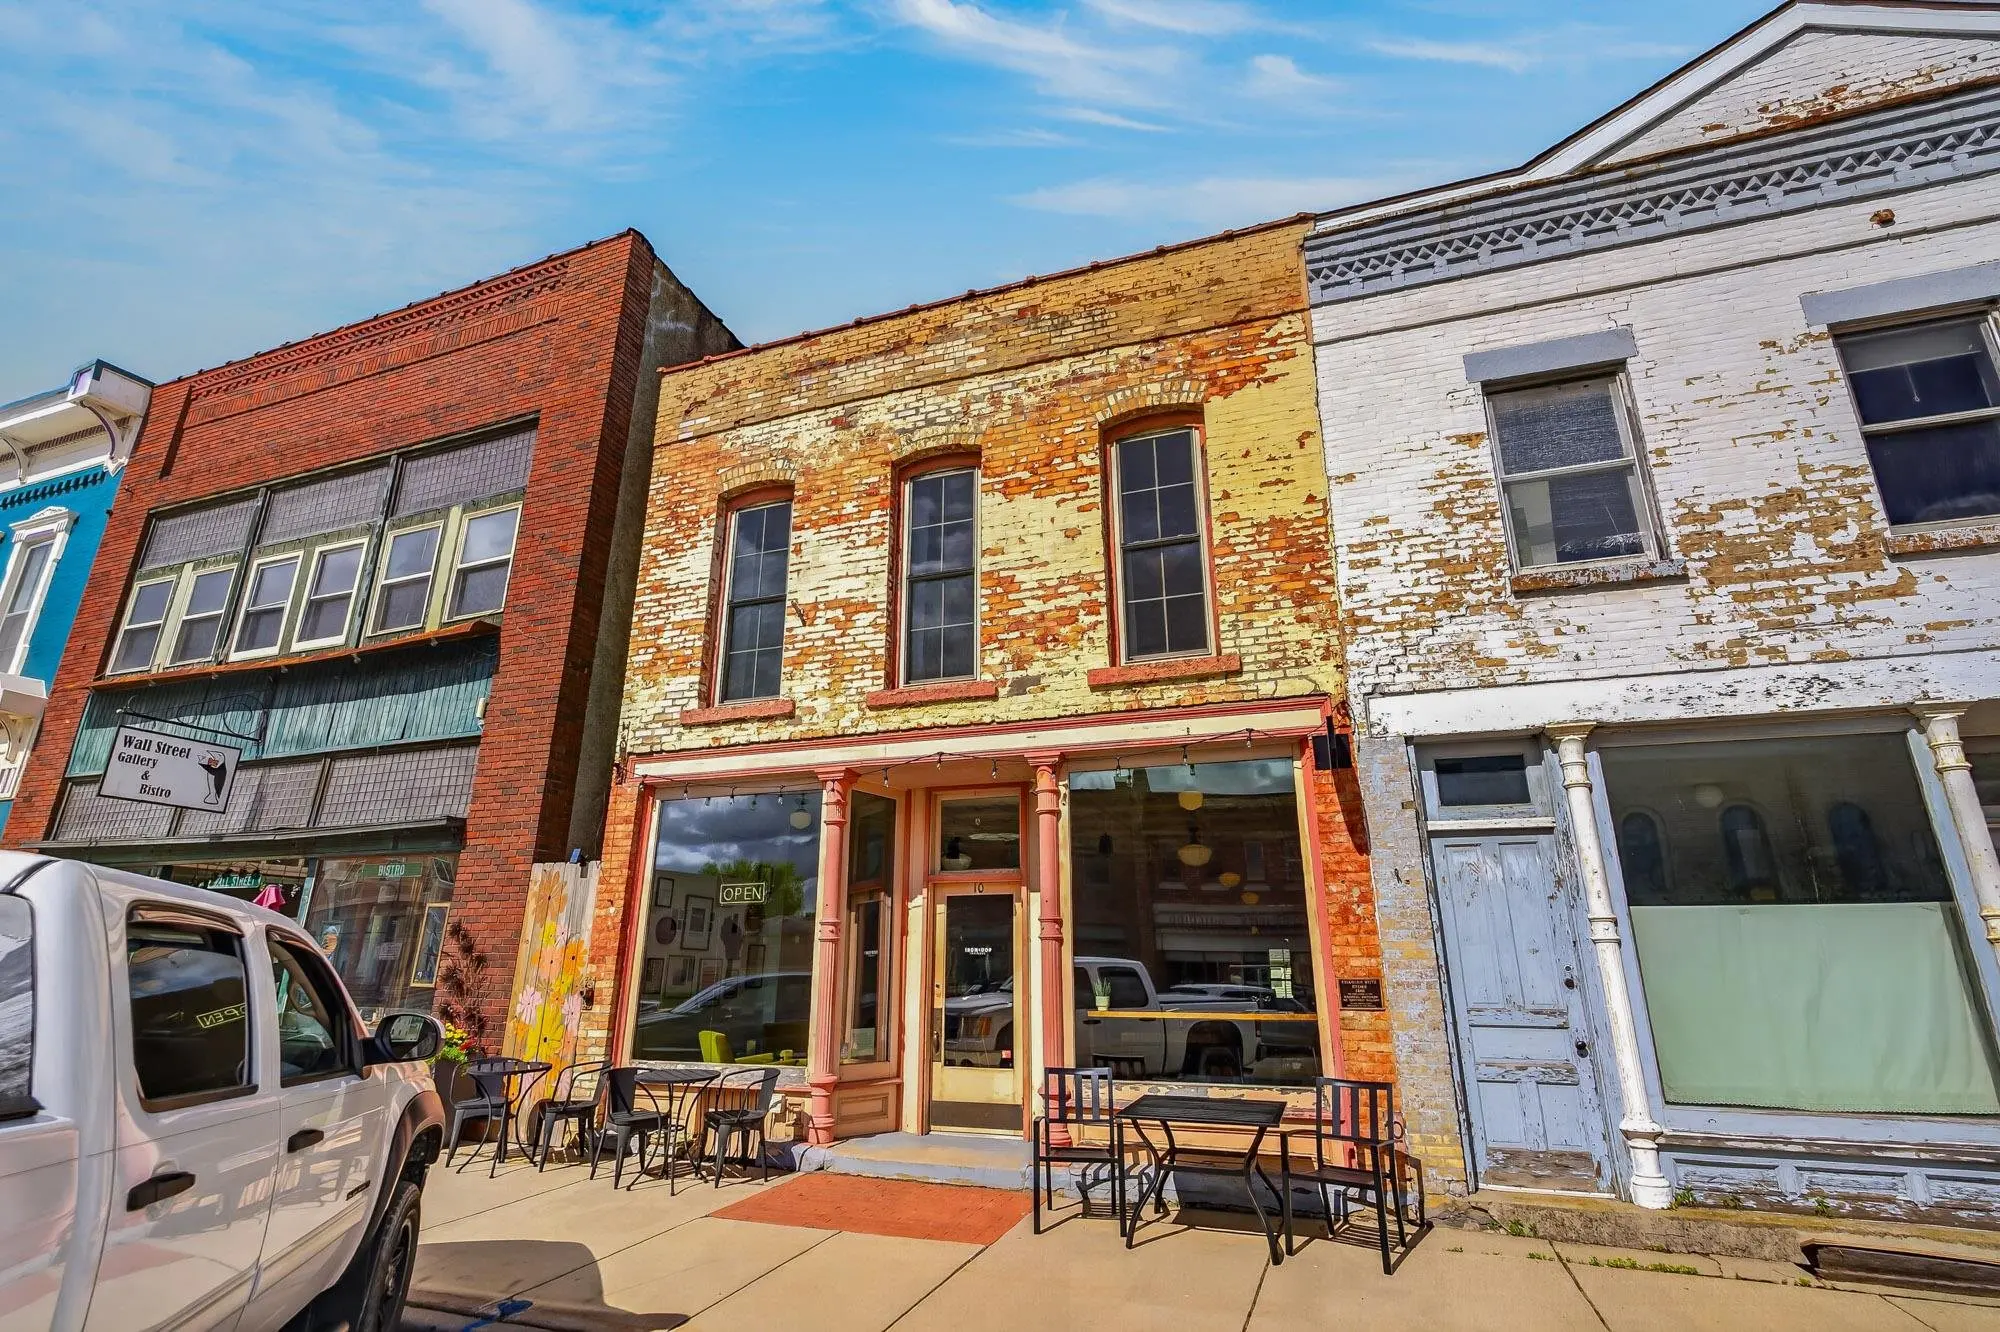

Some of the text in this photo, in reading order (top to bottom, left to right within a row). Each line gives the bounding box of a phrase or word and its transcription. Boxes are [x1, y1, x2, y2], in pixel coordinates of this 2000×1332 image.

[123, 735, 191, 759] Wall Street
[118, 752, 158, 769] Gallery
[141, 770, 150, 781] &
[139, 784, 172, 799] Bistro
[378, 864, 405, 876] BISTRO
[723, 886, 762, 901] OPEN
[974, 882, 984, 893] 10
